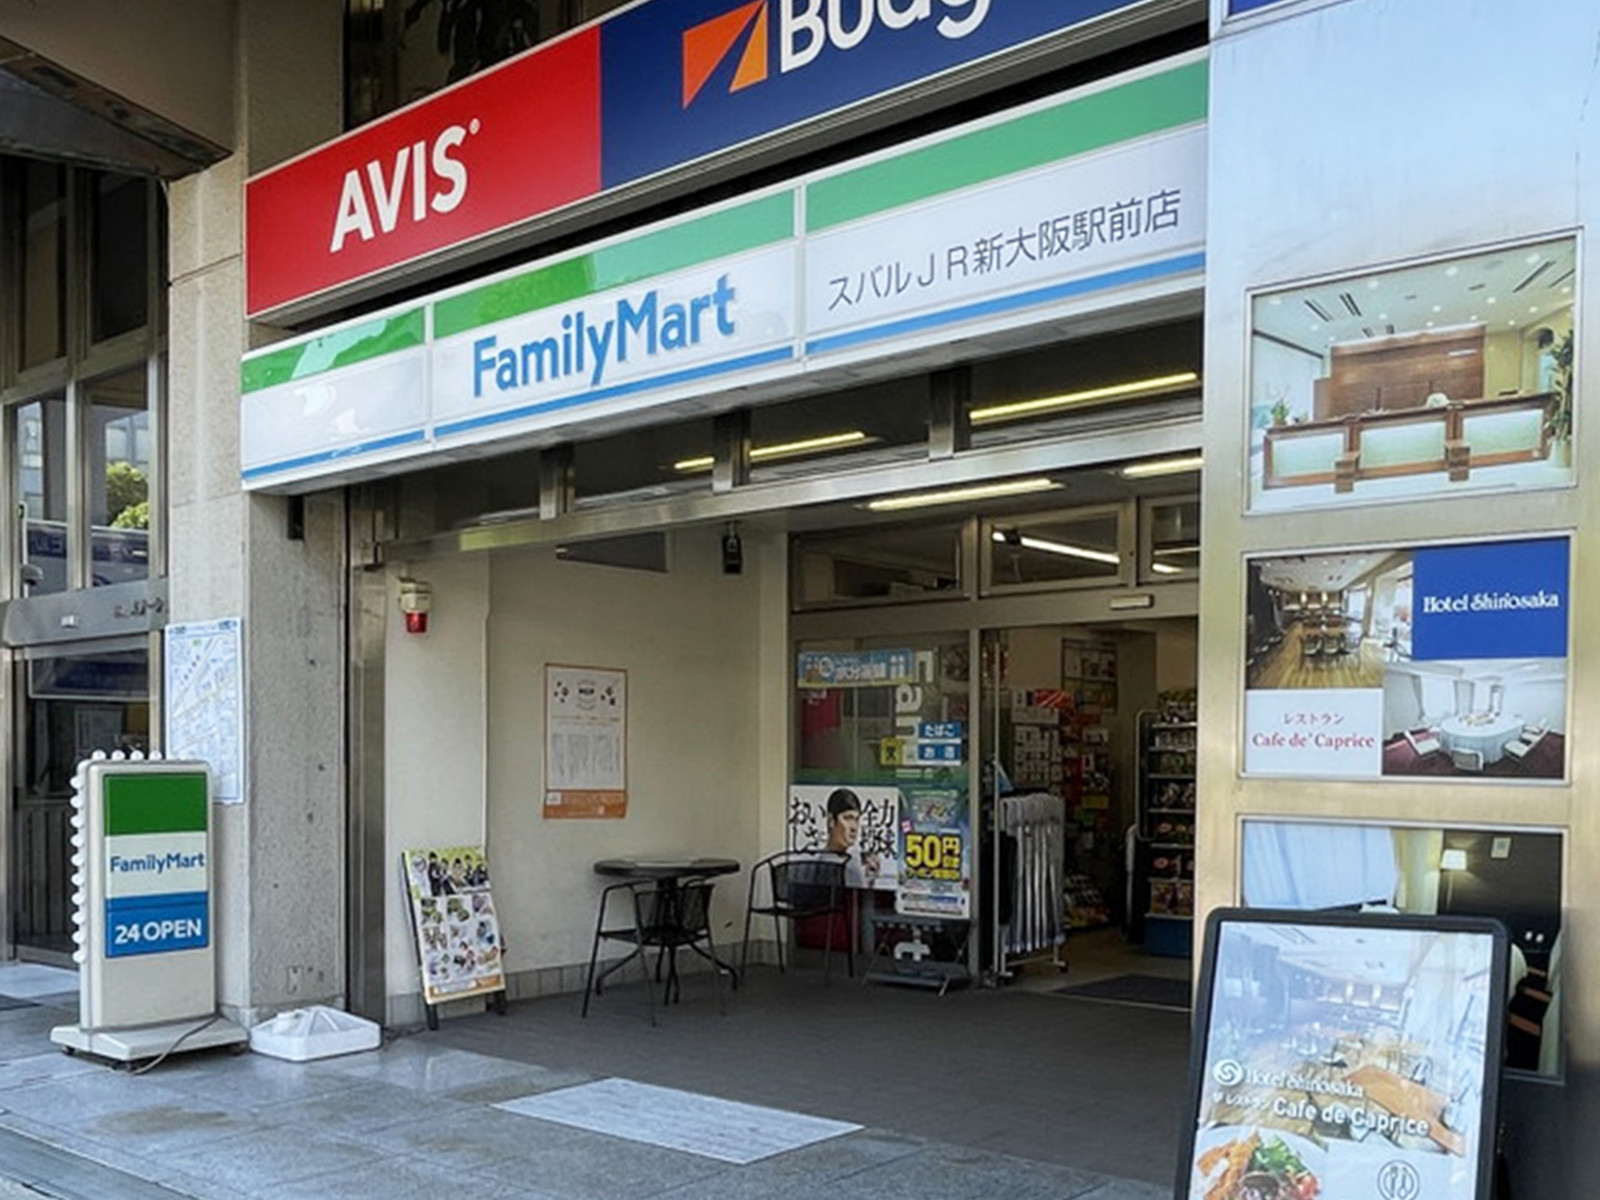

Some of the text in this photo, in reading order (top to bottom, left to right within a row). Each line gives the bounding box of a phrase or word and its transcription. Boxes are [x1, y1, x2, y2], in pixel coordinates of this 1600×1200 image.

[330, 124, 468, 253] AVIS
[828, 189, 1181, 311] スバルJR新大阪駅前店
[474, 273, 735, 398] FamilyMart
[1423, 593, 1469, 613] Hotel
[924, 723, 956, 738] たばこ
[1283, 712, 1345, 725] レストラン
[1251, 732, 1287, 748] Cafe
[1314, 732, 1376, 752] Caprice
[110, 853, 205, 874] FamilyMart
[115, 918, 202, 945] 24 OPEN
[1273, 1097, 1317, 1121] Cafe
[1350, 1107, 1430, 1137] Caprice
